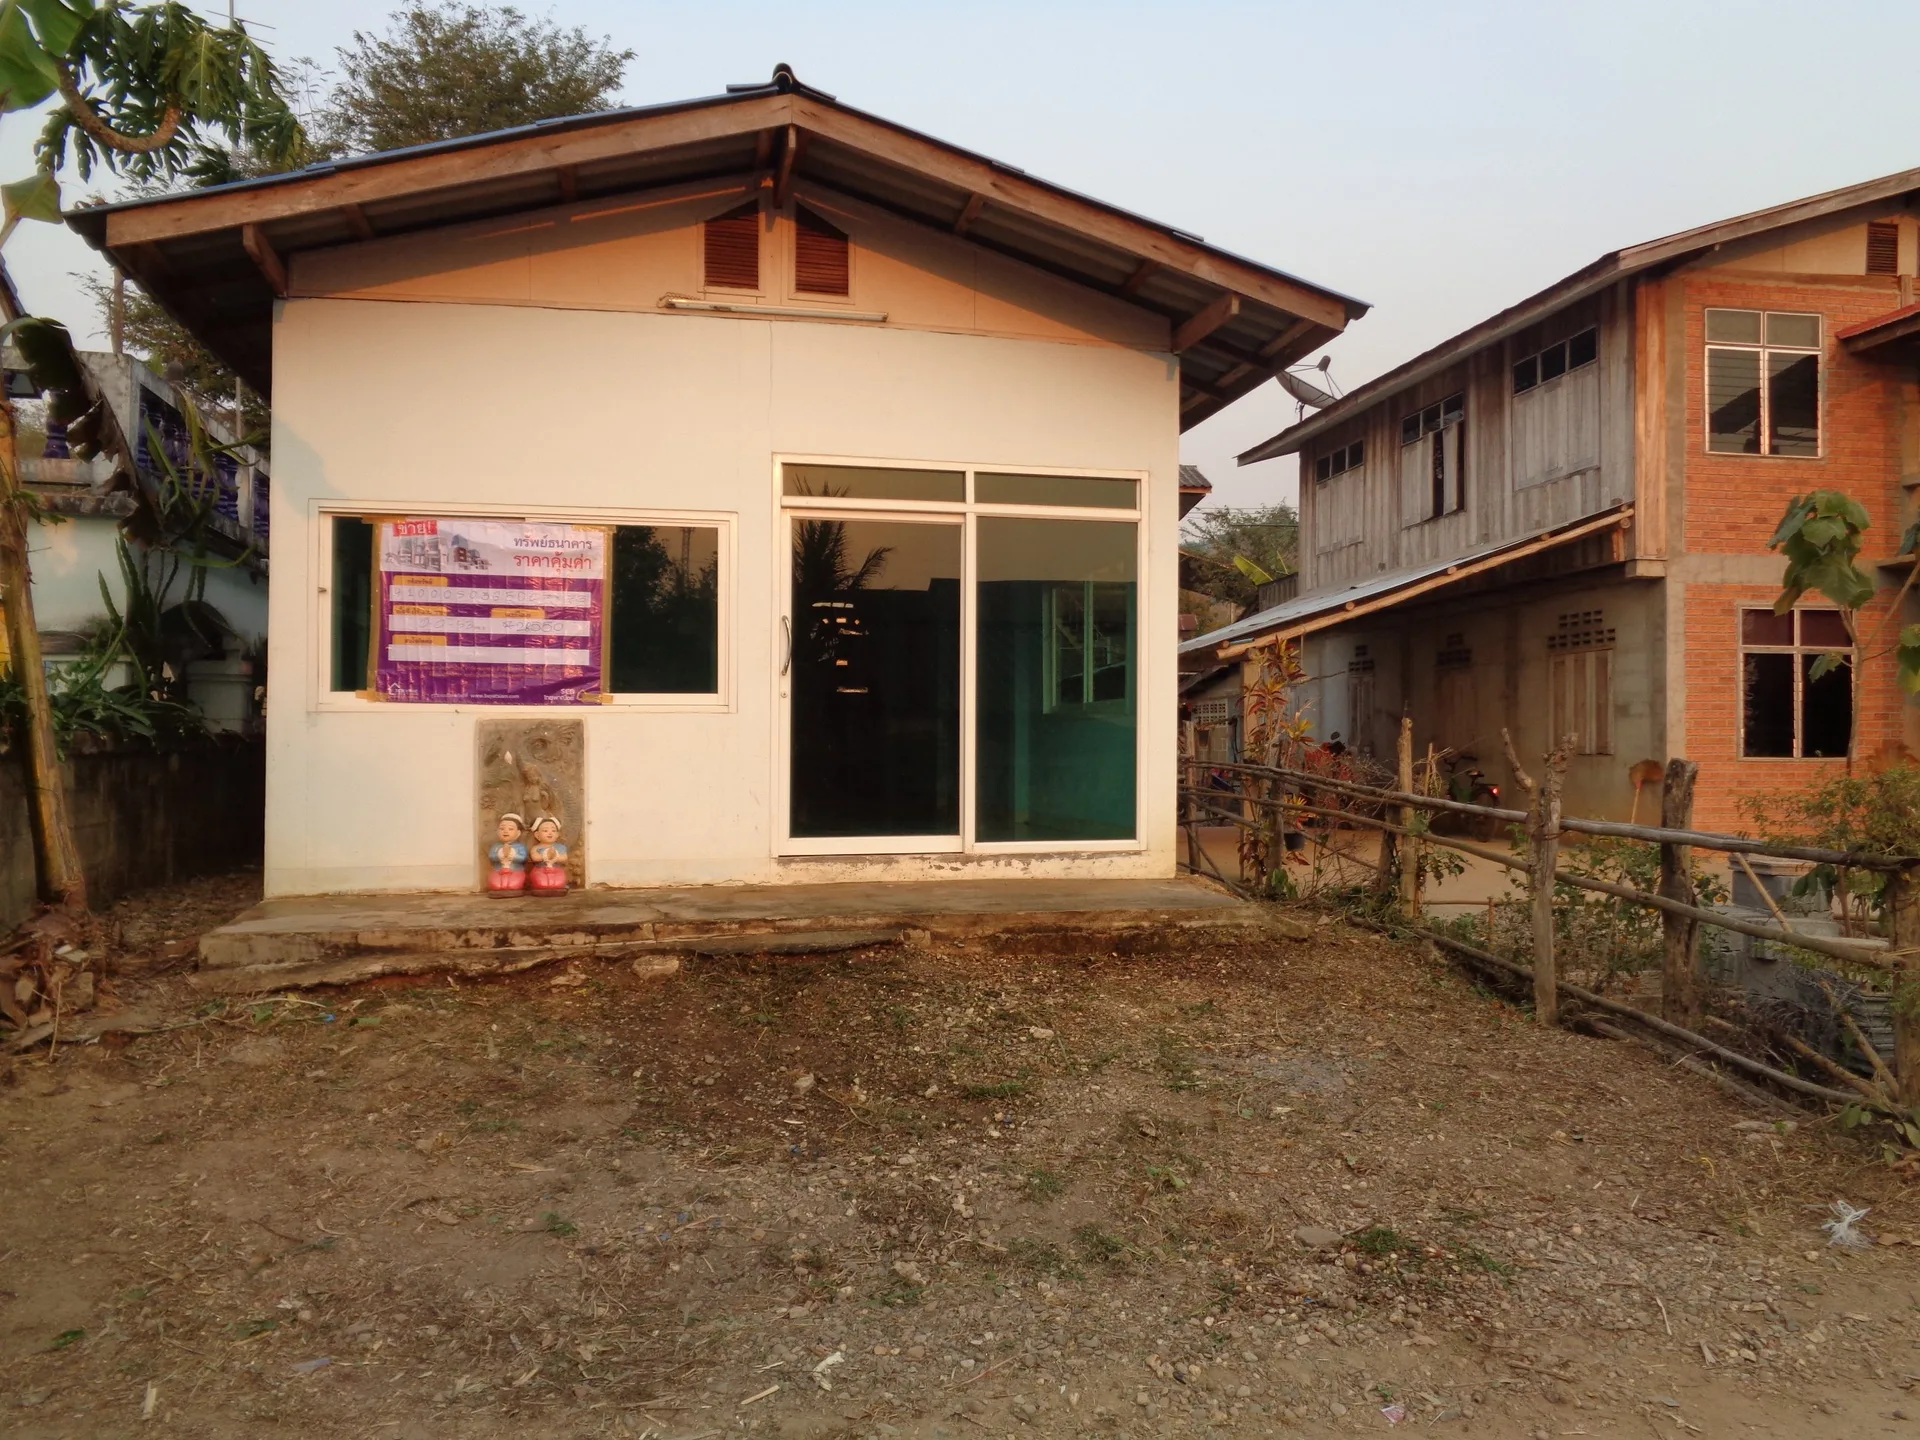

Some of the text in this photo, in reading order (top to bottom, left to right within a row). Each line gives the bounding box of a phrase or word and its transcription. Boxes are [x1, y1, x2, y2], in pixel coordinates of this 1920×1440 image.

[397, 521, 431, 535] ขาย!
[513, 534, 593, 550] ทรัพย์ธนาคาร
[513, 551, 592, 573] ราคาคุ้มค่า
